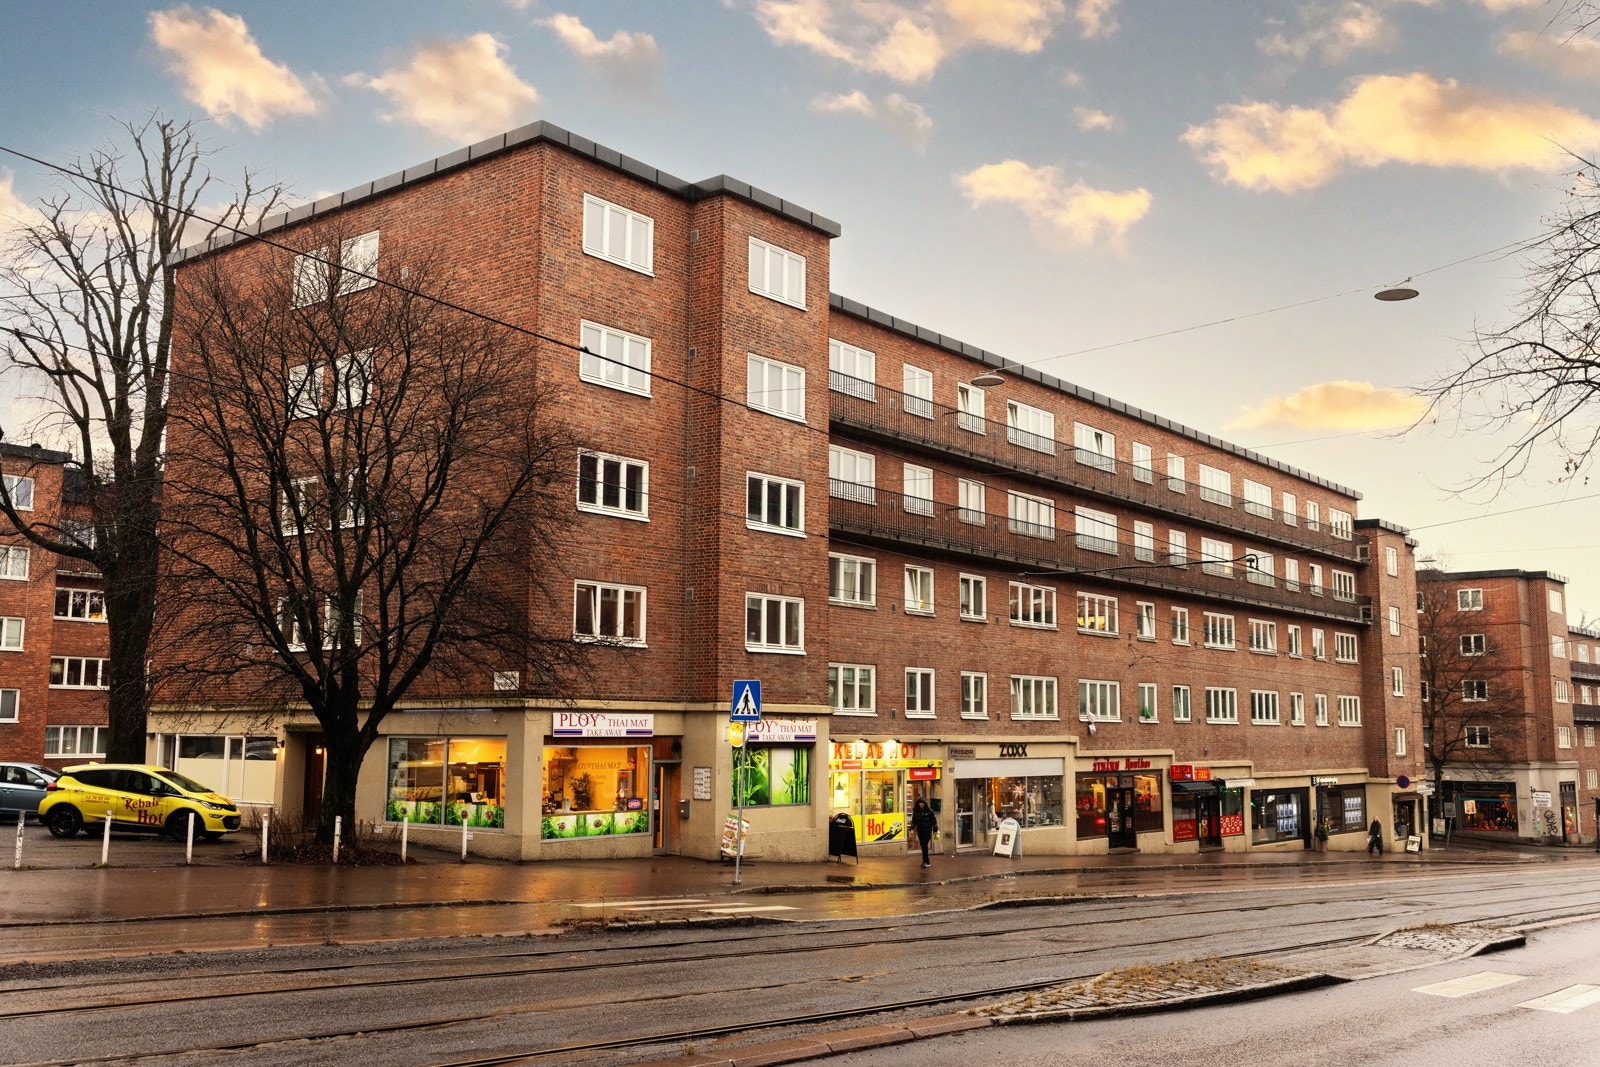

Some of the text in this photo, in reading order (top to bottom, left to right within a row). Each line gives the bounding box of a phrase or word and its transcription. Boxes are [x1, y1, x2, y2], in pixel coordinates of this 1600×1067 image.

[608, 719, 628, 727] THAI
[630, 719, 649, 727] MAT
[780, 725, 797, 733] THAI
[799, 725, 812, 733] MAT
[125, 798, 160, 812] Kebab
[138, 809, 164, 825] Hot
[867, 818, 885, 836] Hot
